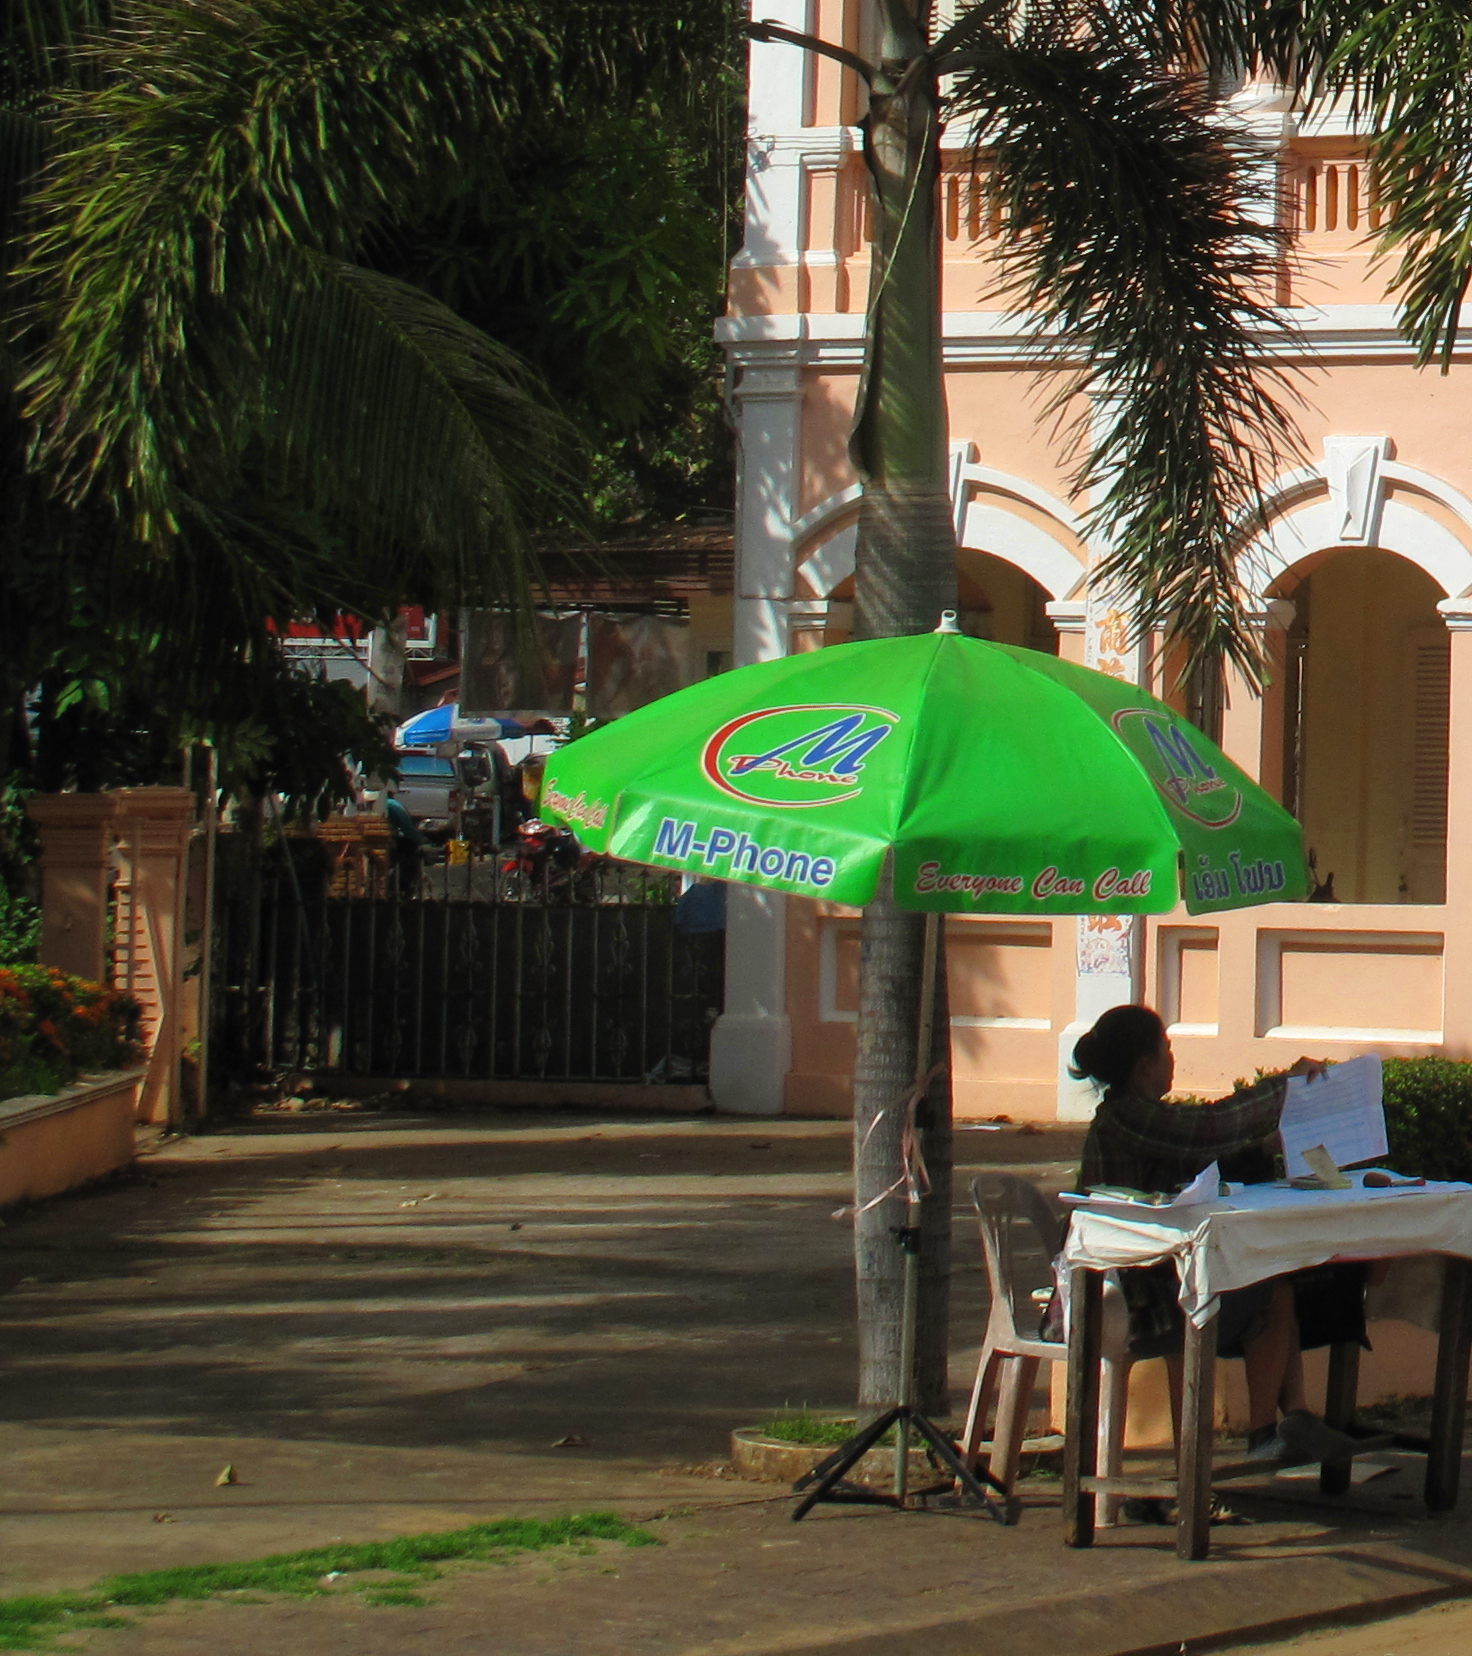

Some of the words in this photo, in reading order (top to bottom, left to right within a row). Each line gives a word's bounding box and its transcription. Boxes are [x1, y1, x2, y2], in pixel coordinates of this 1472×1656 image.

[728, 713, 891, 776] M
[728, 754, 859, 784] Phone
[655, 817, 835, 887] M-Phone
[916, 860, 1024, 896] Everyone
[1031, 867, 1085, 898] Can
[1092, 868, 1152, 900] Call
